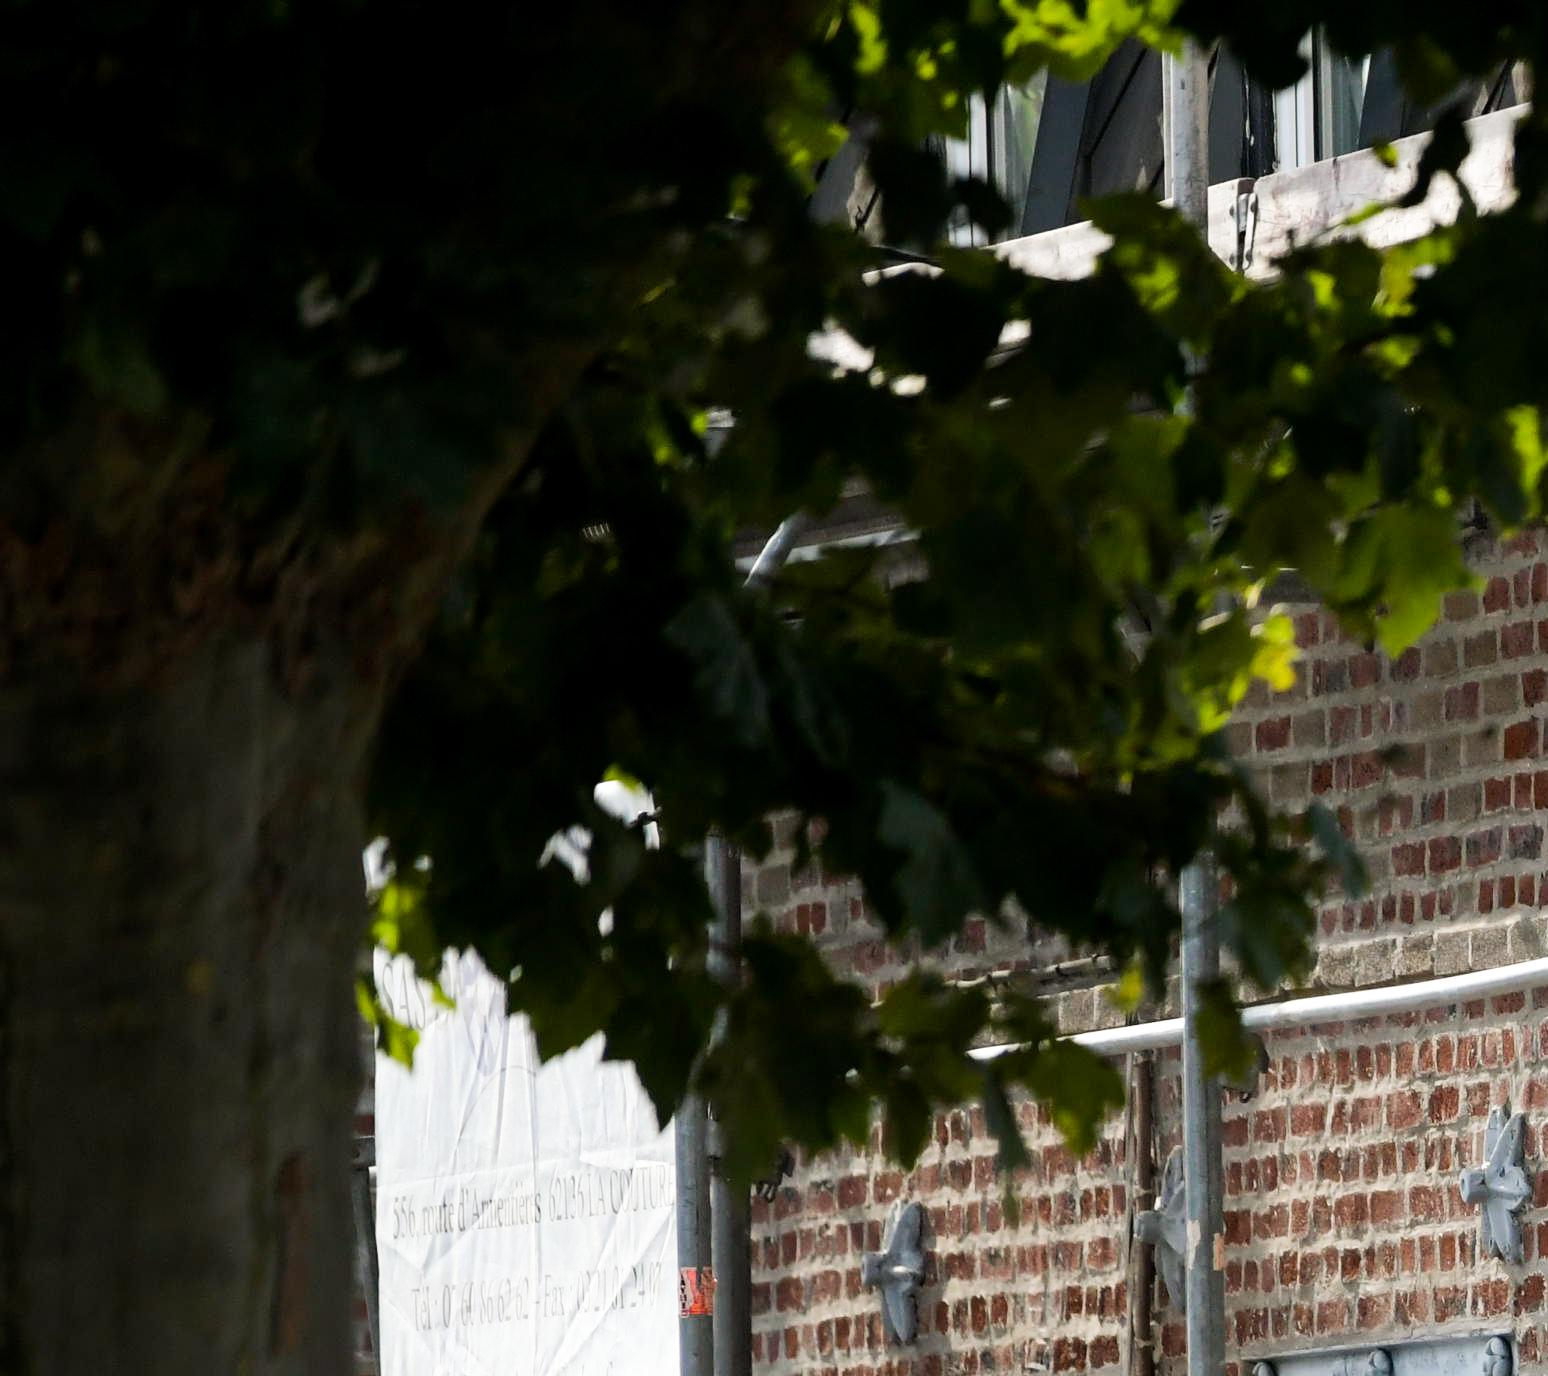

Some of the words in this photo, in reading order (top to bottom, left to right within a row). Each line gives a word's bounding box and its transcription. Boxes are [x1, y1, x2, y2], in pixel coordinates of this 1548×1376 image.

[422, 1191, 455, 1236] route
[548, 1171, 585, 1222] 62136
[588, 1172, 606, 1217] LA
[497, 1277, 512, 1322] 62
[515, 1276, 530, 1320] 62
